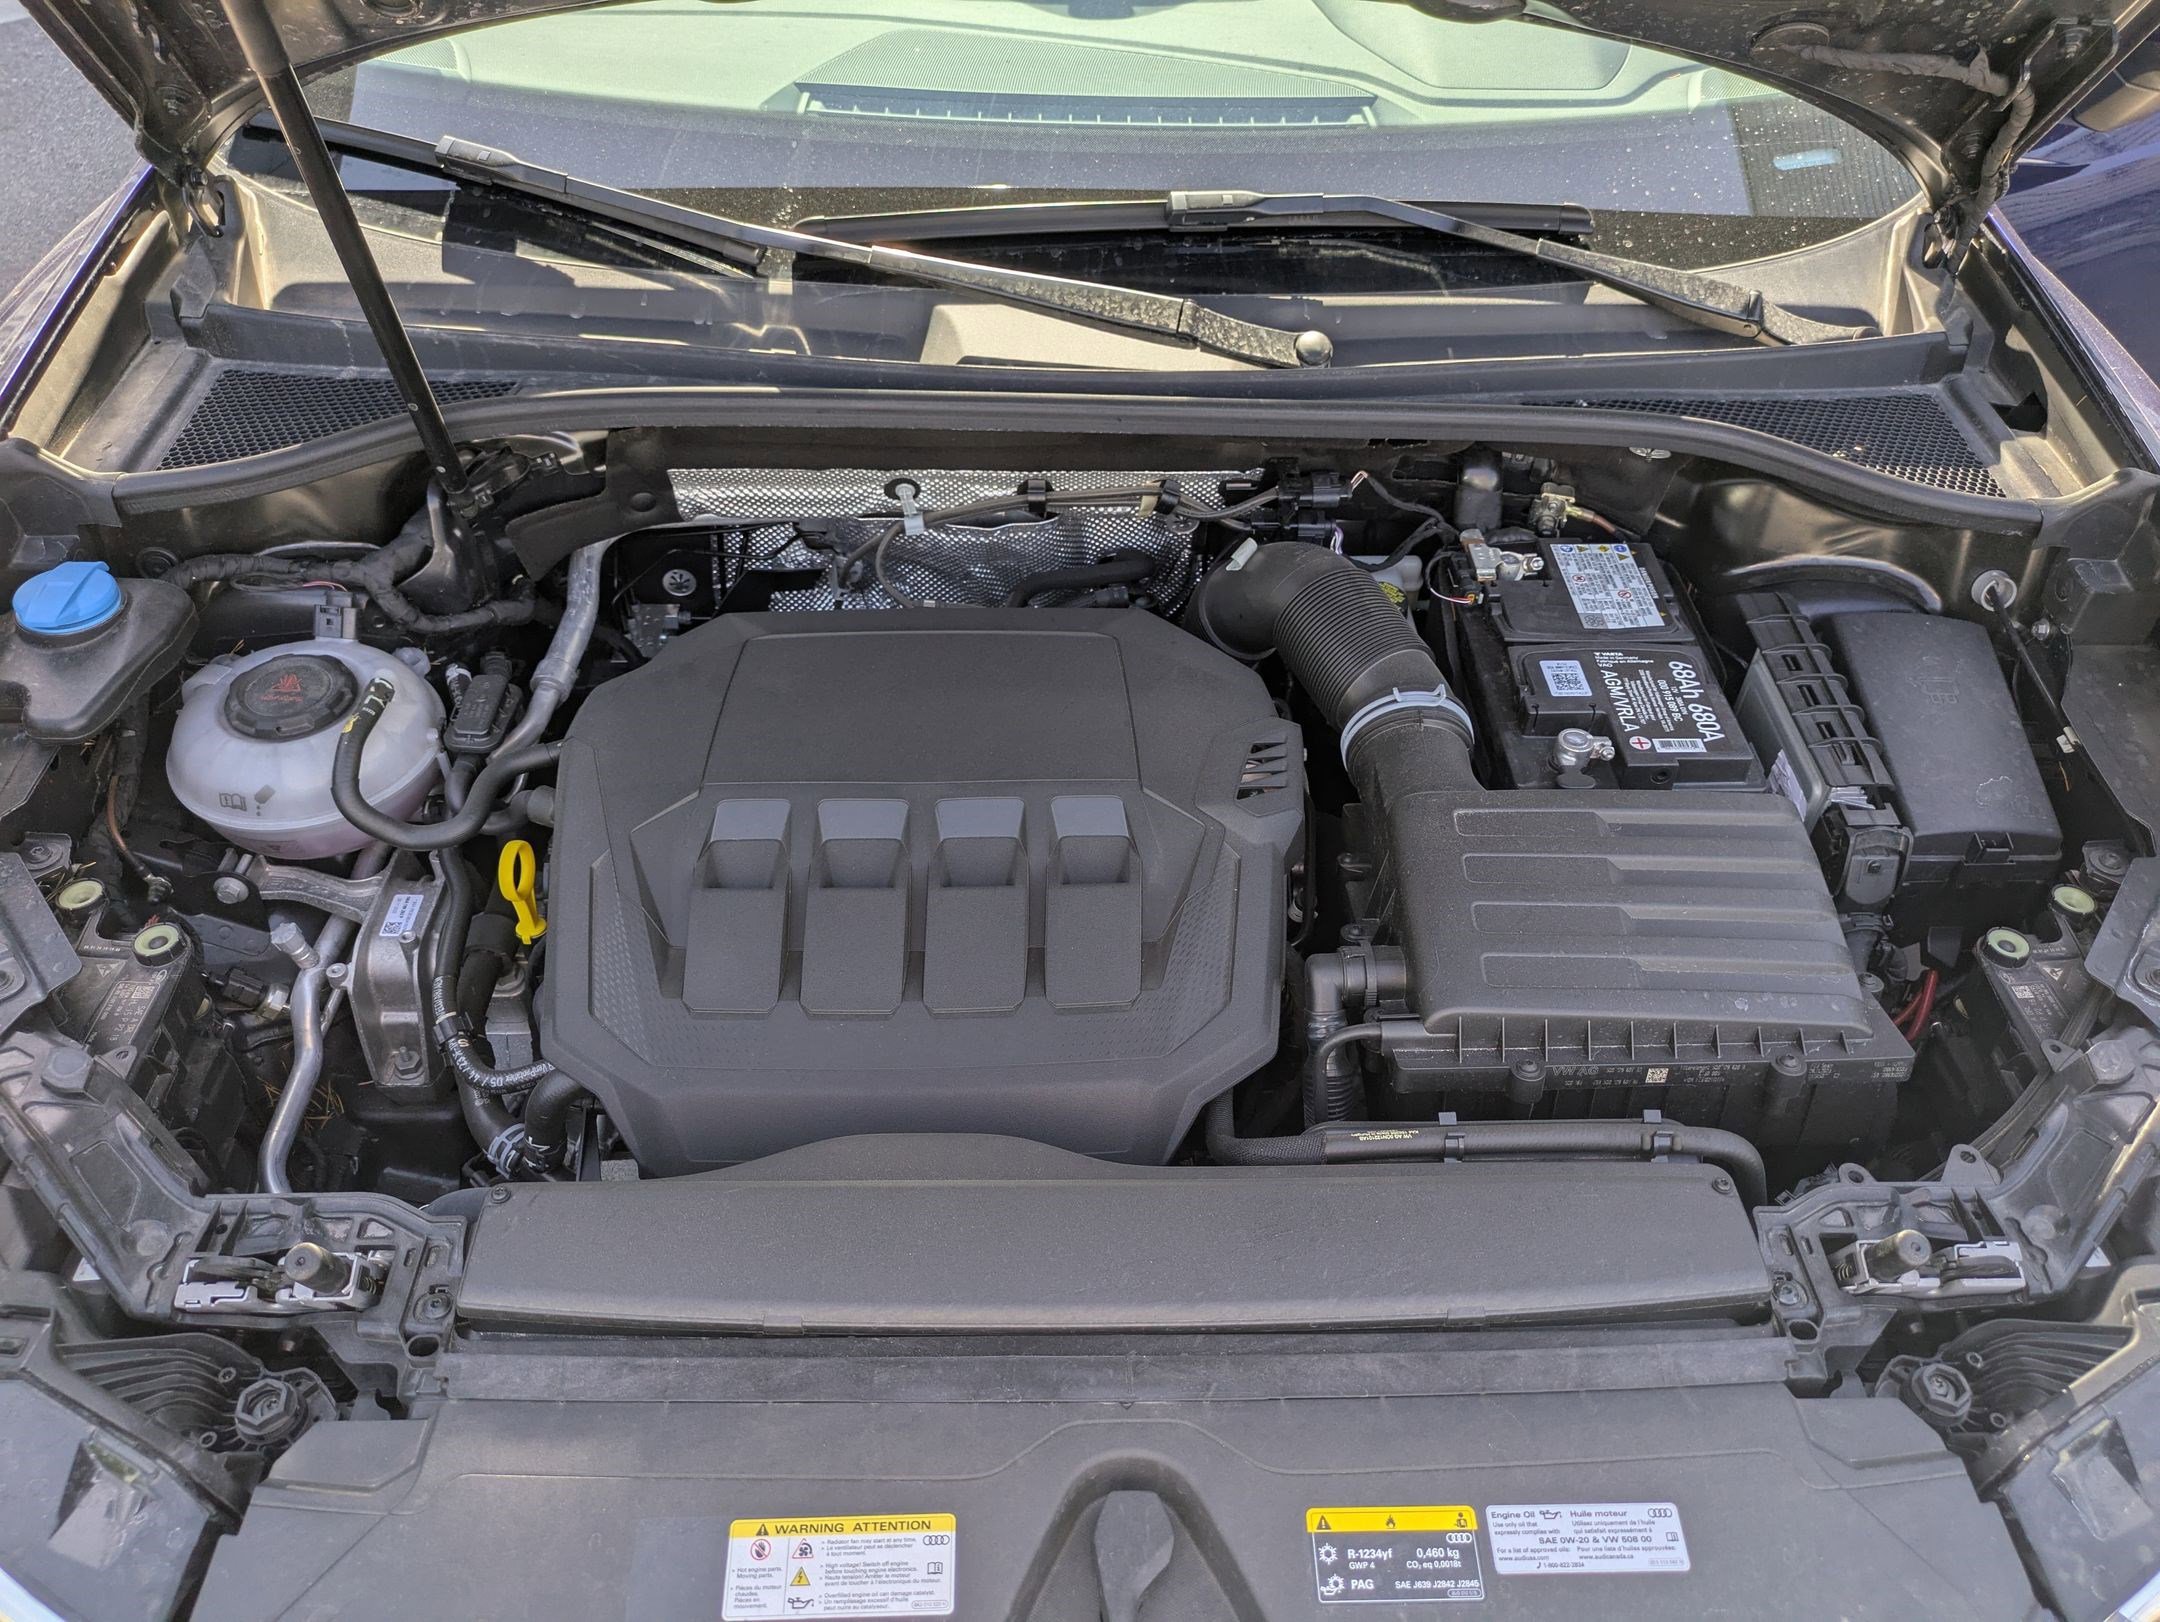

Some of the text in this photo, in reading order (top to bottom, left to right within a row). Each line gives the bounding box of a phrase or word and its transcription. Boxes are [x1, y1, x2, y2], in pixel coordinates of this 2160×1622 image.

[1662, 688, 1674, 700] 915
[1600, 670, 1640, 732] AGM/VRLA
[1668, 661, 1704, 699] 68Ah
[1688, 703, 1726, 742] 680A
[775, 1520, 931, 1534] WARNING ATTENTION
[1347, 1549, 1392, 1560] R-1234yf
[1416, 1548, 1460, 1559] 0,460 kg
[1351, 1579, 1374, 1589] PAG
